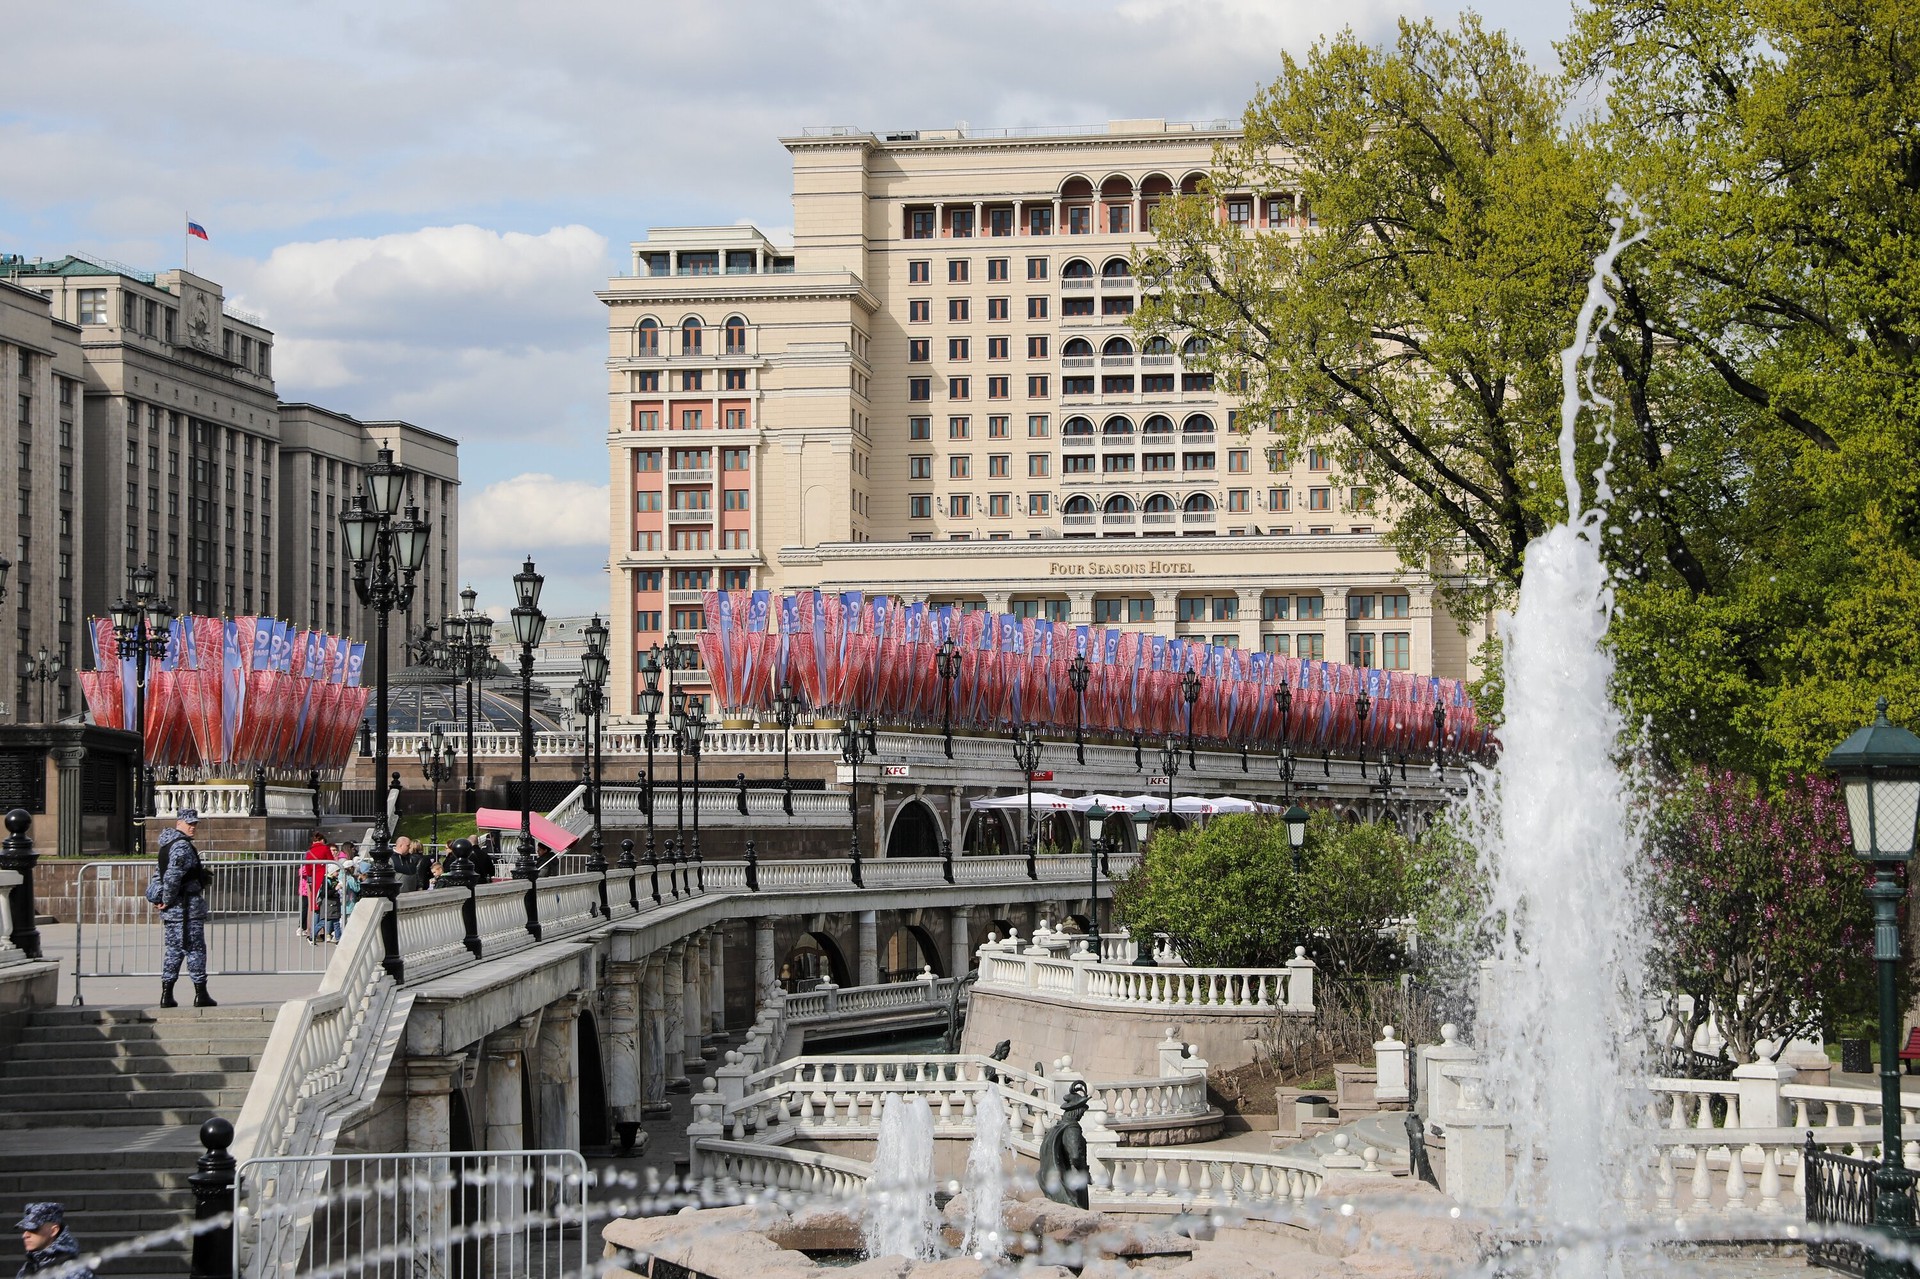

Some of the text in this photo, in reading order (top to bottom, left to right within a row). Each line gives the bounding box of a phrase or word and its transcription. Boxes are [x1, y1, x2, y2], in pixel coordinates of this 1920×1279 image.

[757, 600, 766, 616] 9
[850, 601, 859, 616] 9
[877, 606, 885, 624] 9
[256, 631, 269, 649] 9
[1003, 624, 1012, 641] 9
[272, 635, 281, 654] 9
[1077, 634, 1086, 651] 9
[1108, 638, 1116, 655] 9
[1153, 644, 1161, 661] 9
[350, 654, 361, 671] 9
[885, 767, 906, 775] KFC
[1150, 777, 1168, 785] KFC
